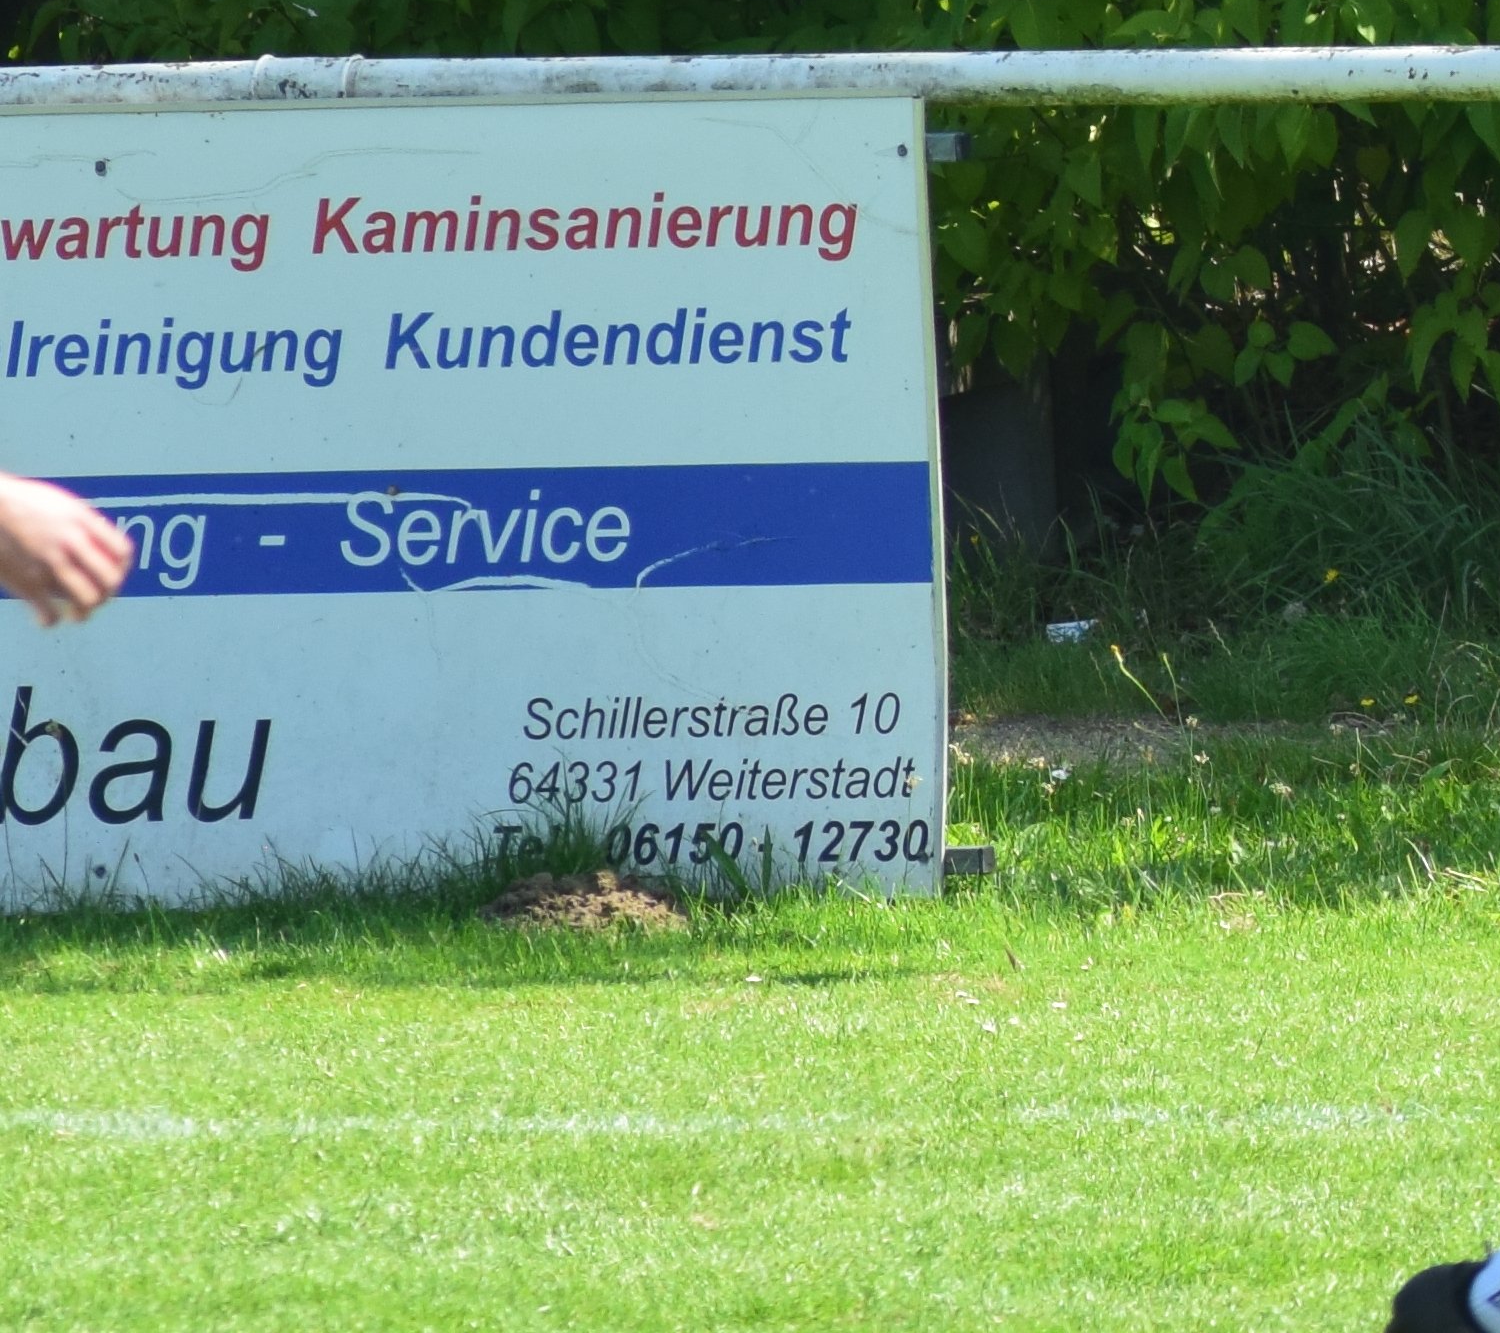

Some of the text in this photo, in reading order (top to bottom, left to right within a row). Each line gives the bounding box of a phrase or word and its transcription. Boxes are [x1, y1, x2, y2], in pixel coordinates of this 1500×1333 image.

[0, 191, 858, 272] wartung Kaminsanierung
[0, 307, 852, 390] lreinigung Kundendienst
[341, 488, 631, 567] Service
[522, 691, 902, 740] Schillerstraße 10
[0, 686, 271, 827] bau
[508, 756, 916, 804] 64331 Weiterstadt
[793, 819, 929, 863] 12730
